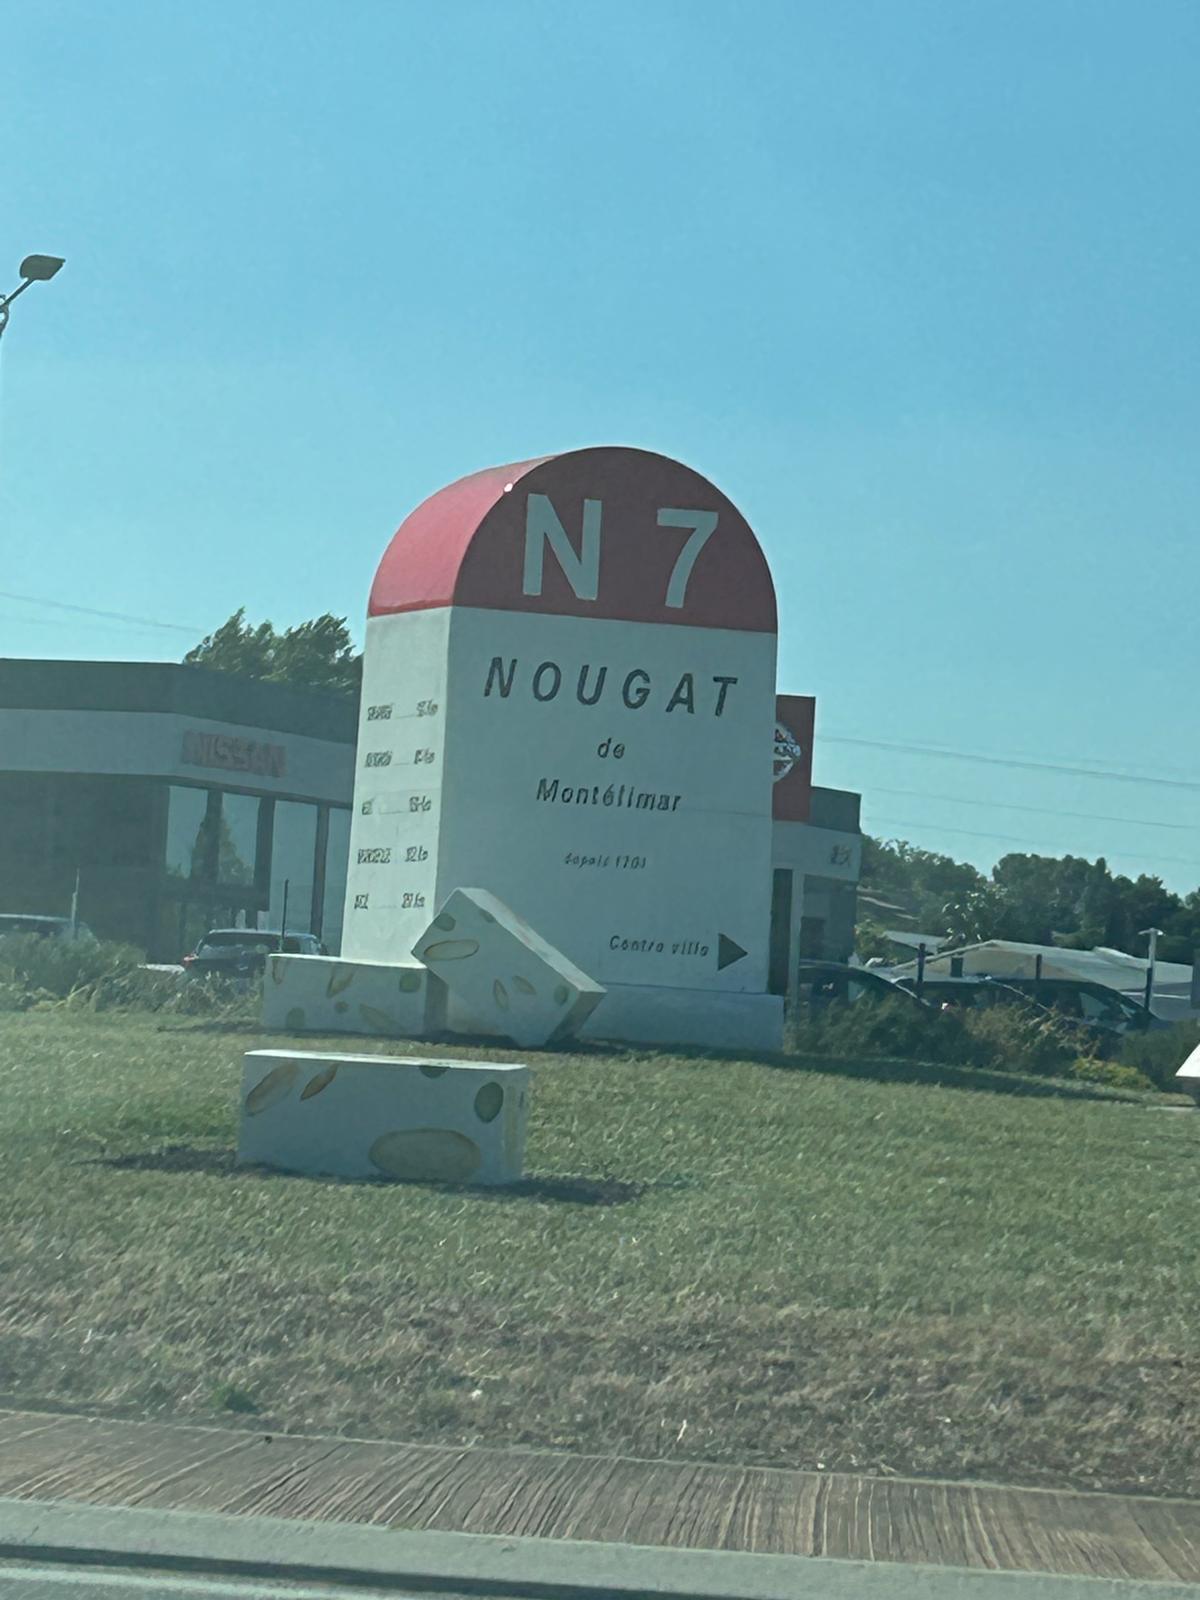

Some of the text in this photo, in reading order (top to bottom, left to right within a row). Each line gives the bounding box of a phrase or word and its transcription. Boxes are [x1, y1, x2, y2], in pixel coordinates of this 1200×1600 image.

[522, 493, 719, 609] N 7
[483, 656, 738, 717] NOUGAT
[597, 737, 625, 759] de
[536, 778, 682, 812] Montélimar
[609, 935, 710, 957] Centre ville
